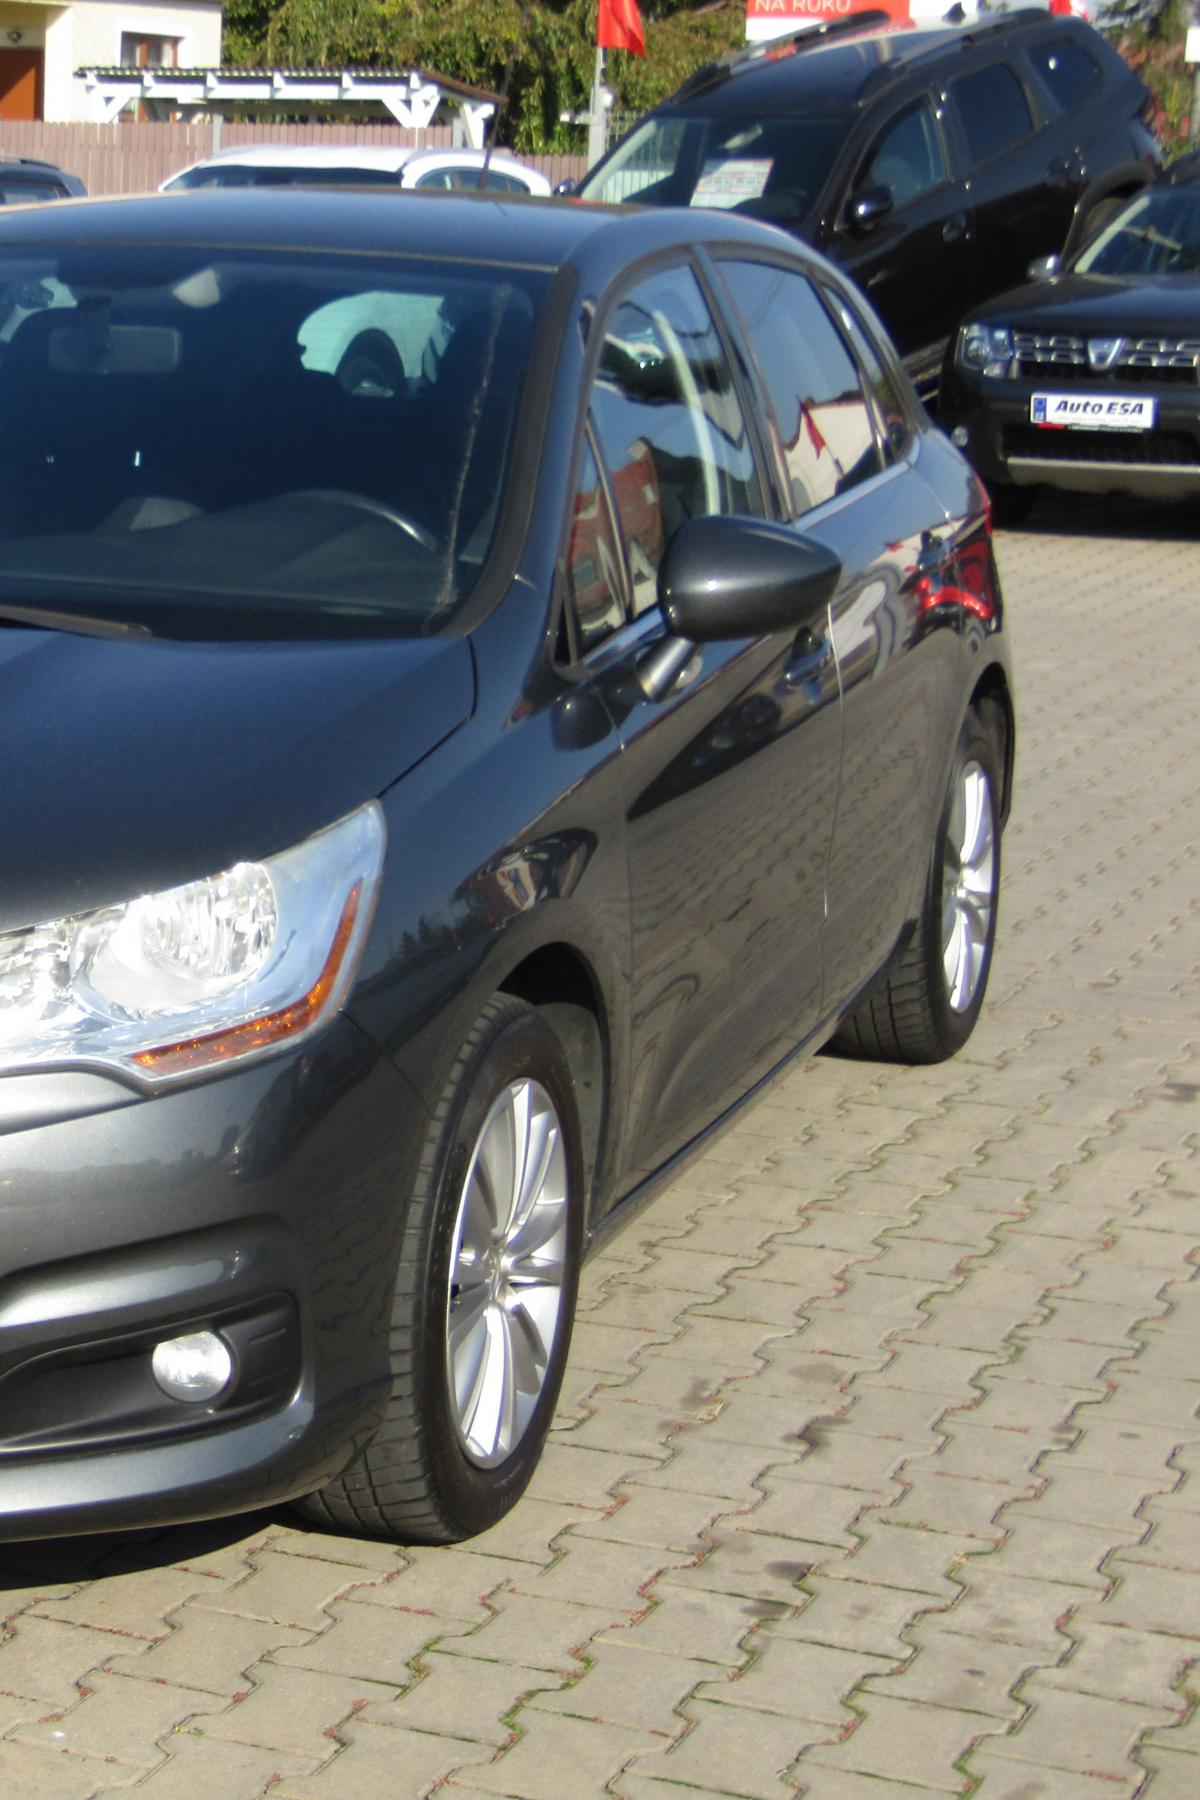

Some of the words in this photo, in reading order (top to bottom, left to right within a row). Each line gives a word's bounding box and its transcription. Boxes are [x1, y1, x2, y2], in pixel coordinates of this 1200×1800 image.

[755, 0, 785, 13] NA
[1054, 400, 1103, 415] Auto
[1106, 401, 1144, 416] ESA
